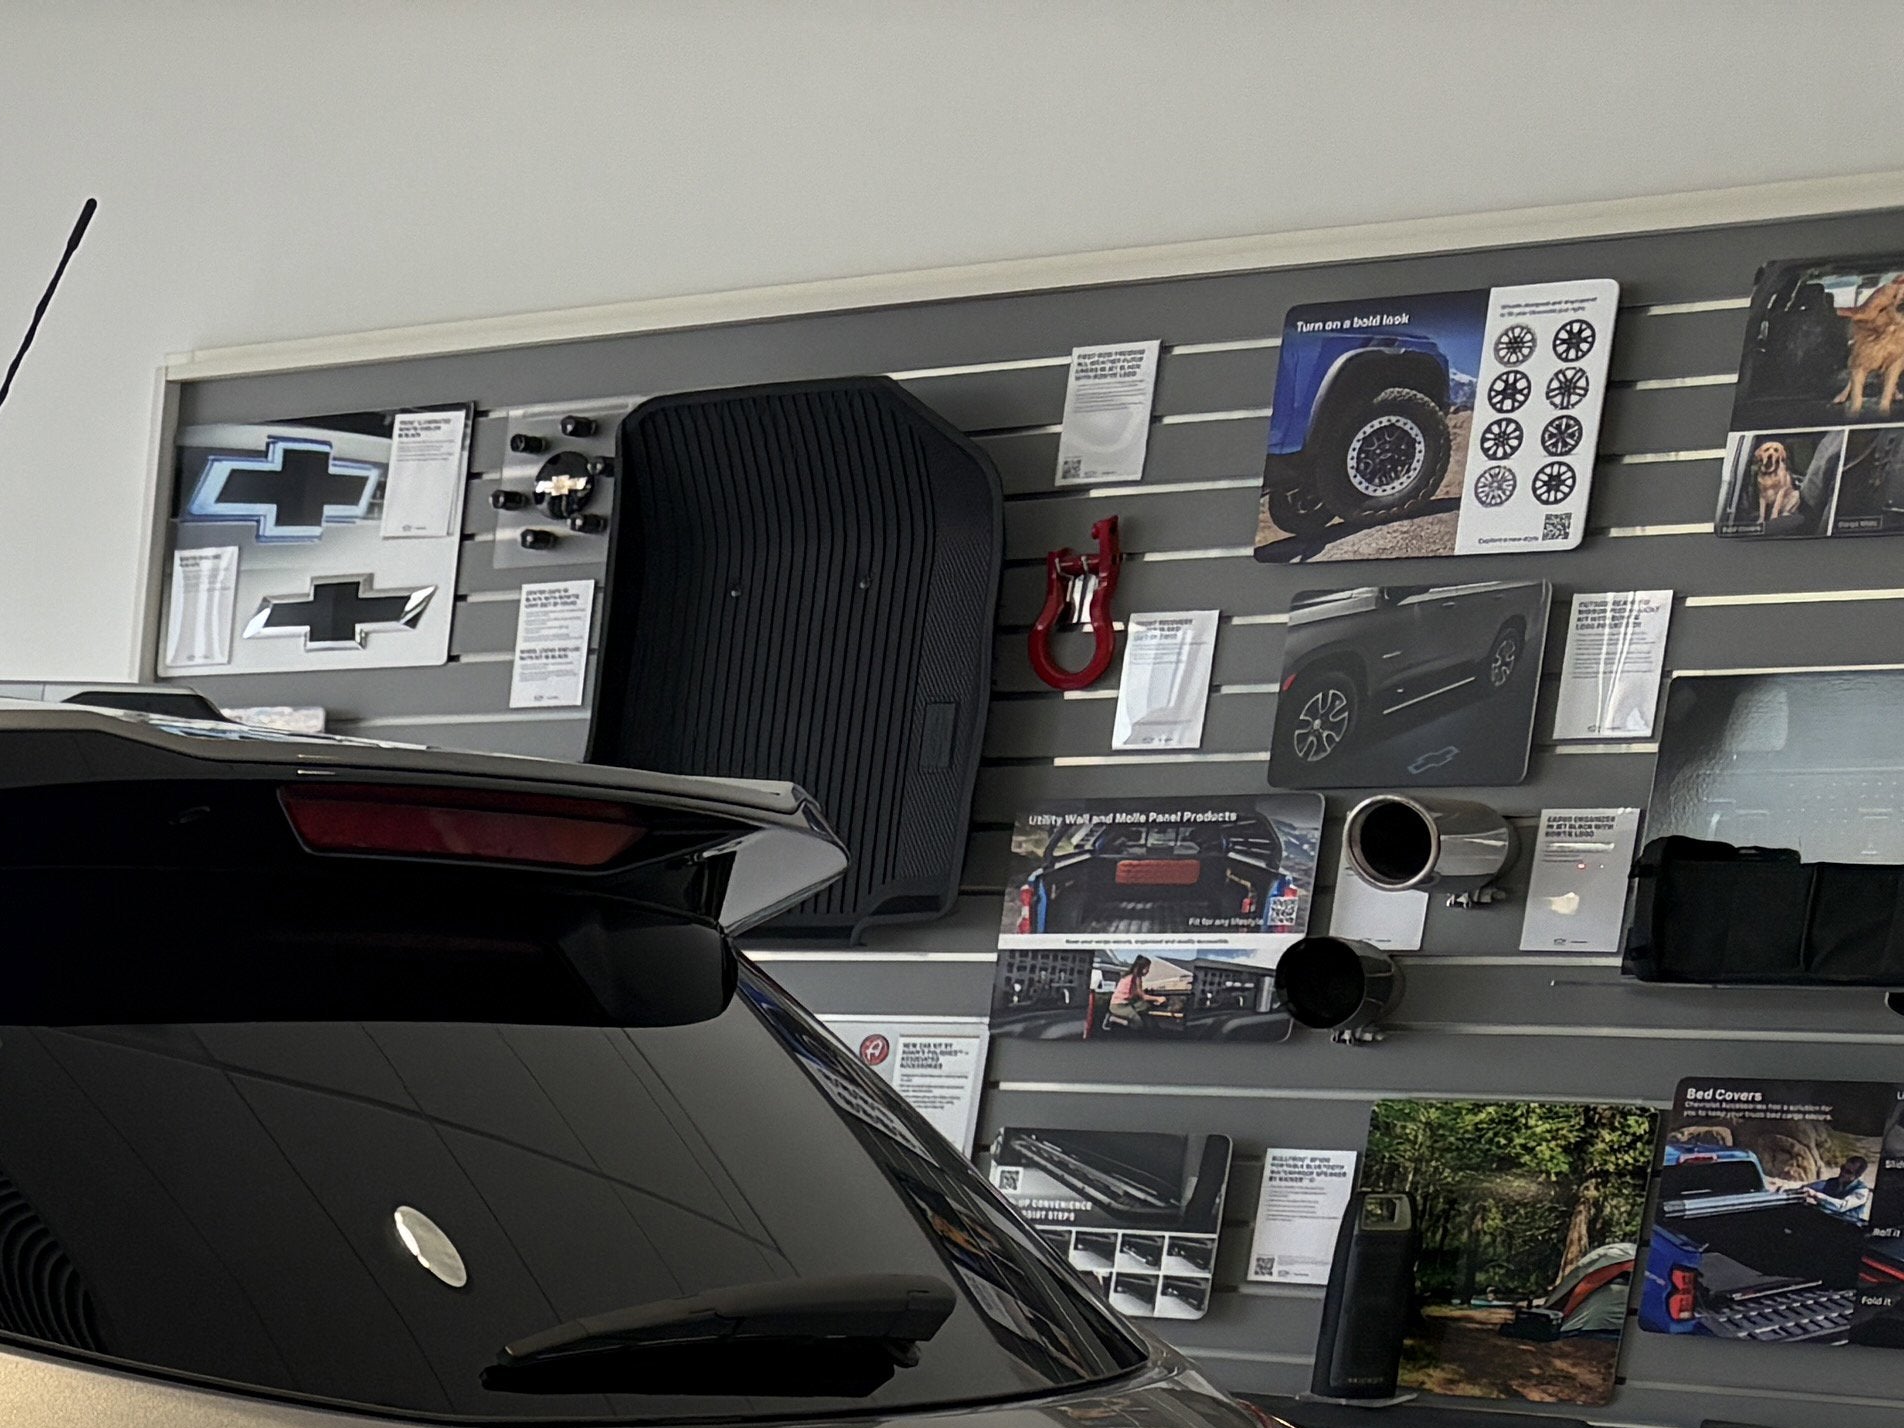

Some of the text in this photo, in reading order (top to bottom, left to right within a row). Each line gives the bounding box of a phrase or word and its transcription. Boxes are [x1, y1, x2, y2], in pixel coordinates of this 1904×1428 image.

[1297, 313, 1410, 332] Turn on a bold look
[1029, 810, 1237, 826] Utility Wall and Molle Panel Products
[1189, 917, 1264, 928] Fit for any lifestyle
[1686, 1088, 1763, 1101] Bed Covers
[1032, 1199, 1092, 1211] CONVENIENCE
[1861, 1296, 1892, 1306] Fold it
